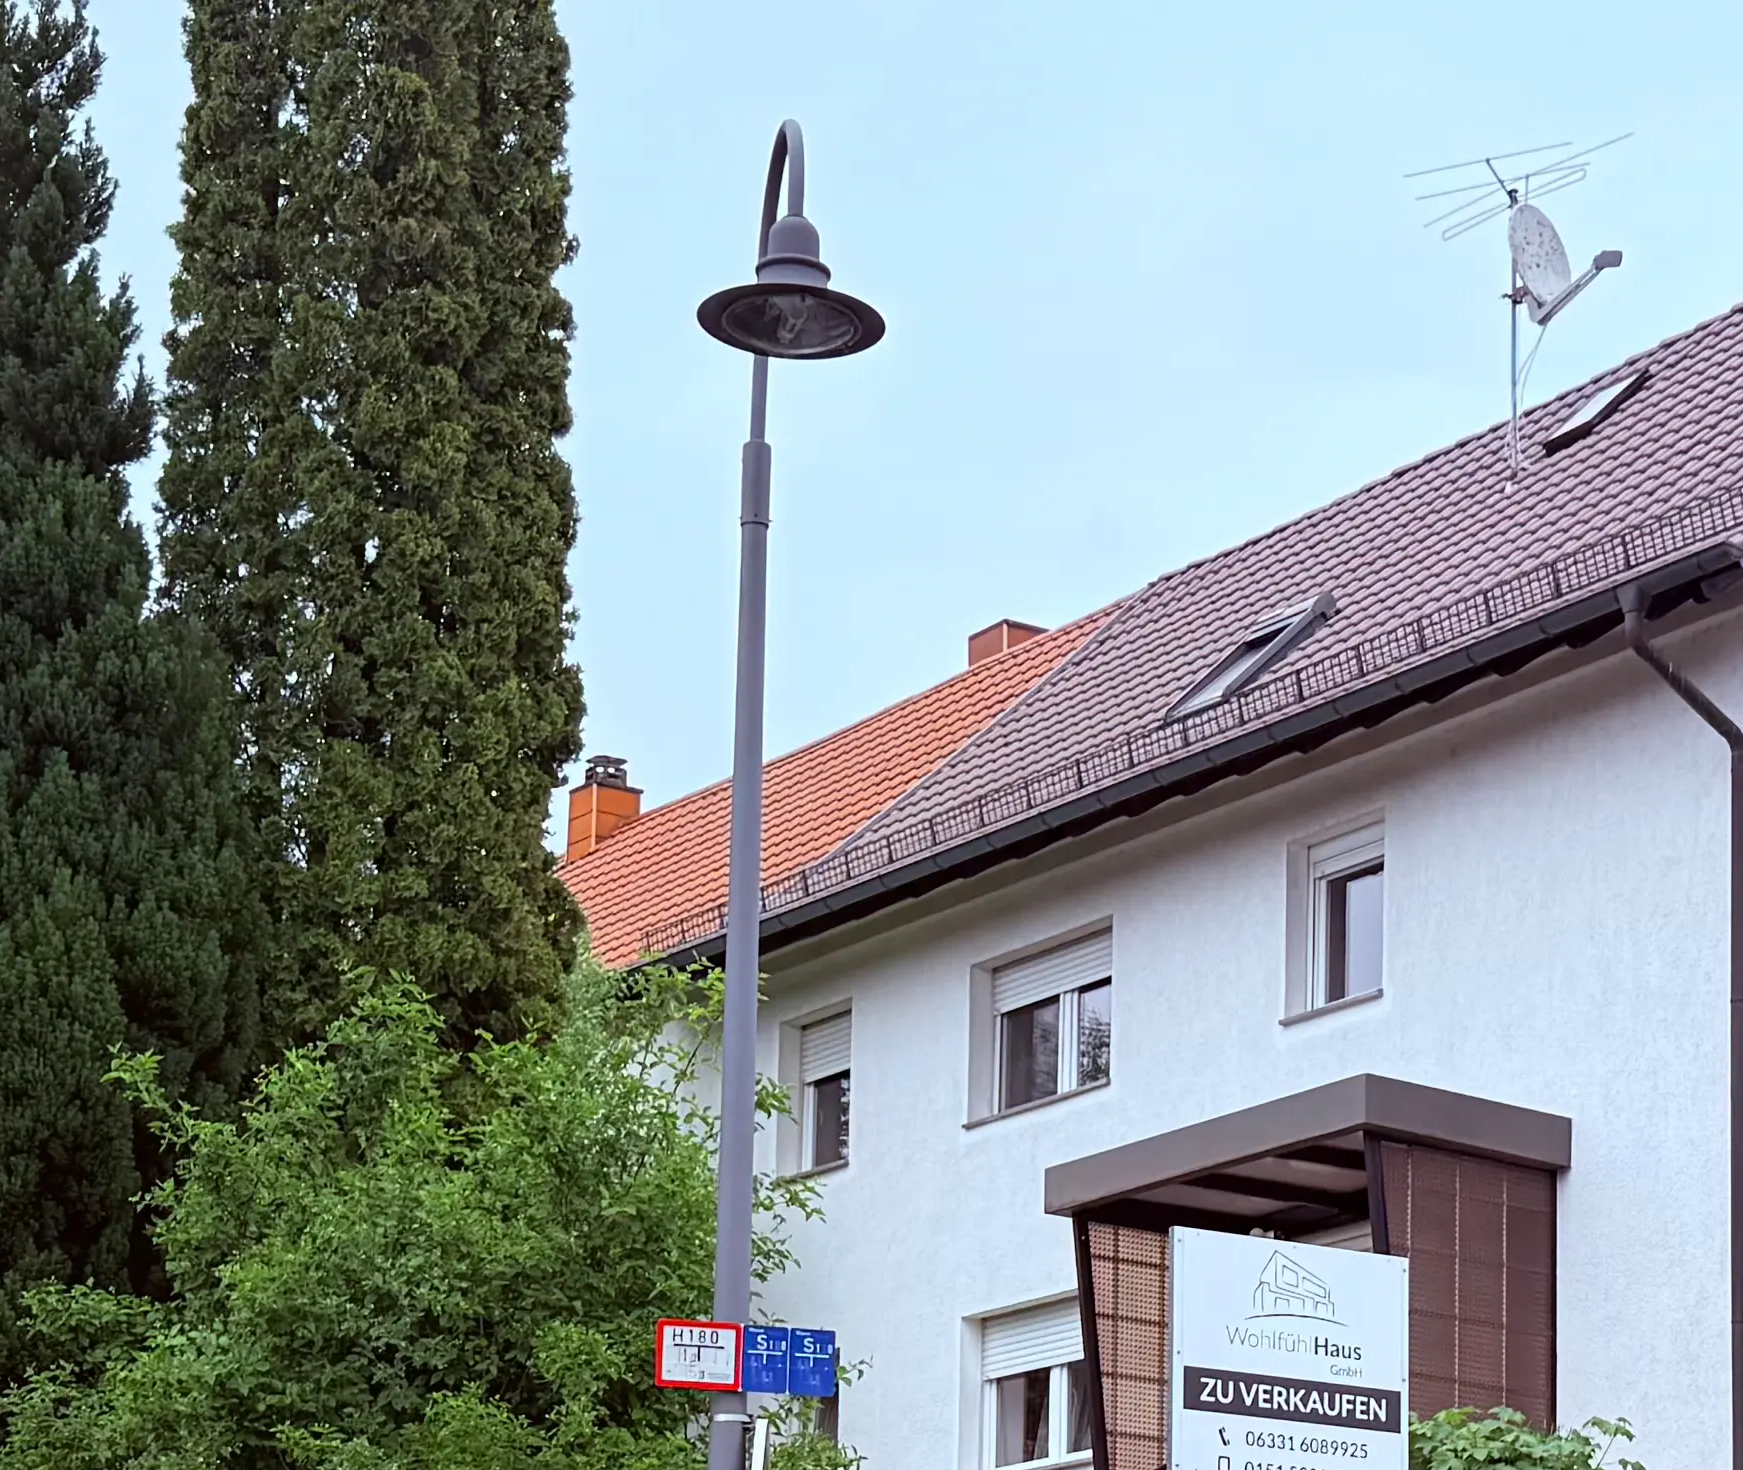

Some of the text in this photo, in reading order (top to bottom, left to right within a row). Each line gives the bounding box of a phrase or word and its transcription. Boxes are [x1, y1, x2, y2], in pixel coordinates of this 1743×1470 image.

[1226, 1325, 1362, 1361] WohlfühlHaus
[1330, 1364, 1363, 1379] GmbH
[1199, 1377, 1387, 1422] ZU VERKAUFEN
[1245, 1431, 1368, 1460] 06331 6089925
